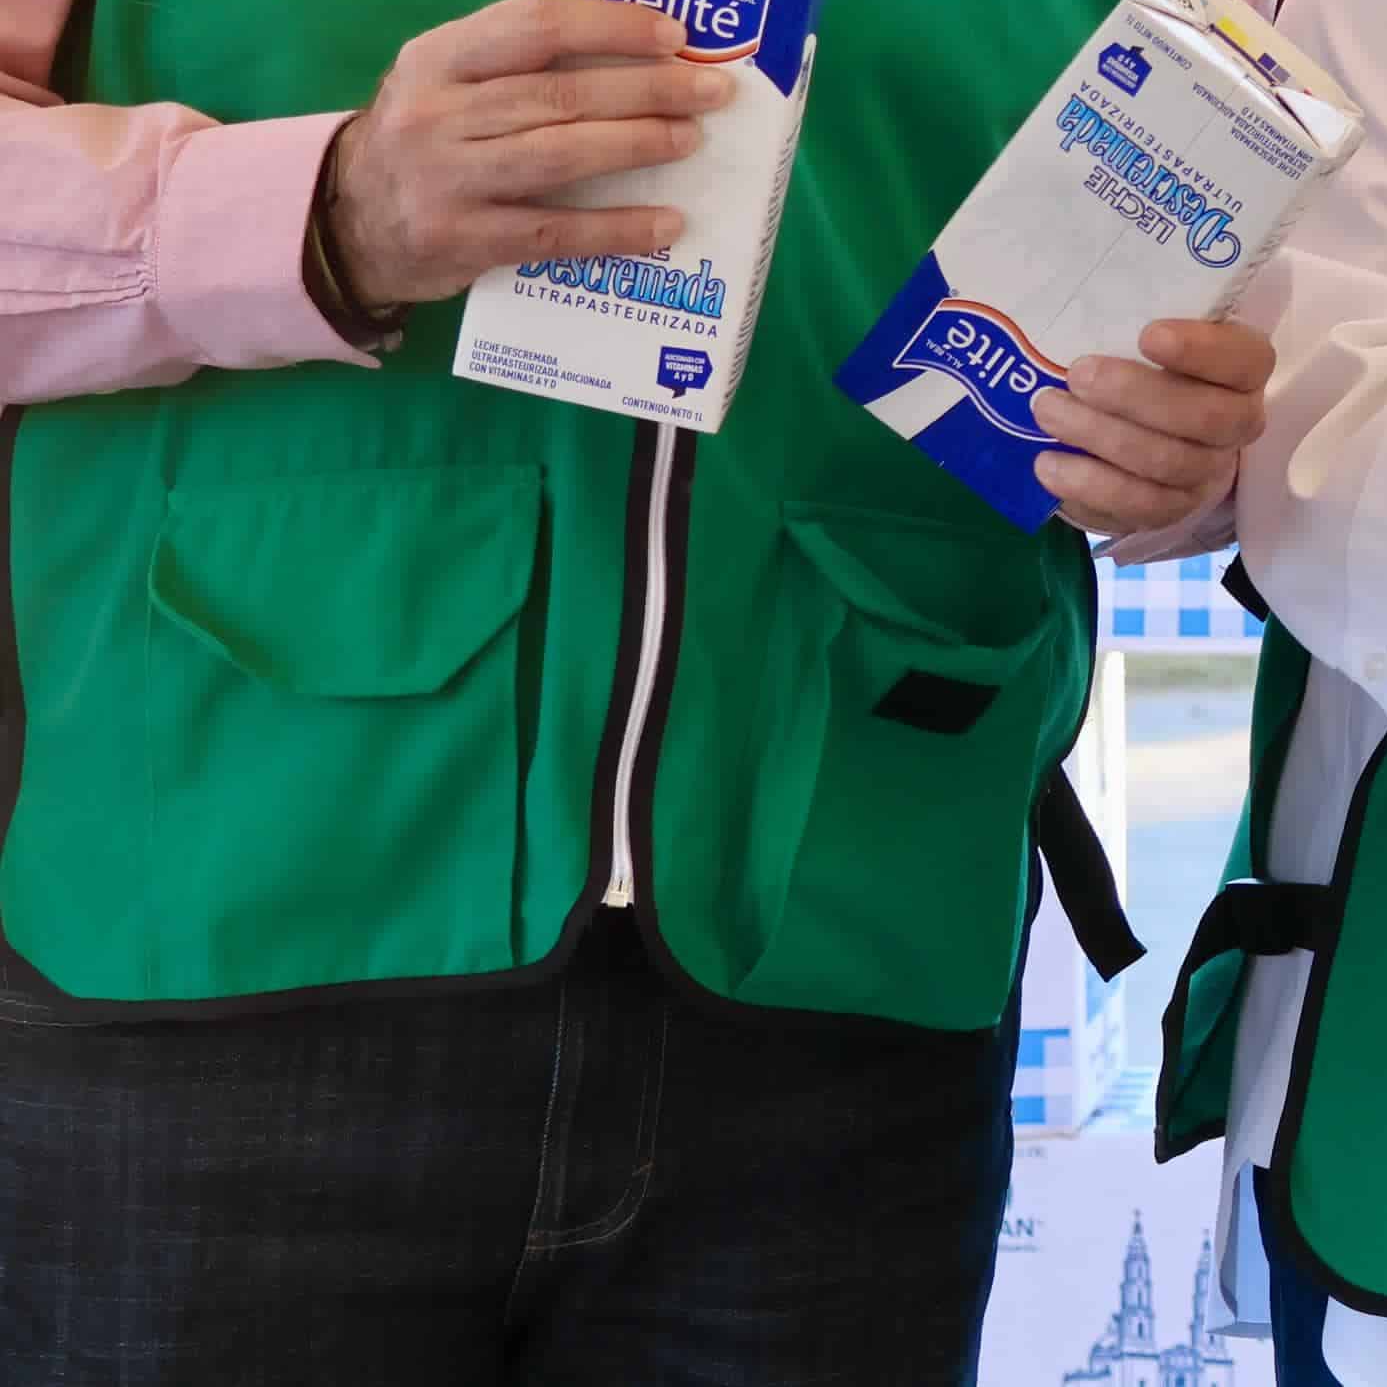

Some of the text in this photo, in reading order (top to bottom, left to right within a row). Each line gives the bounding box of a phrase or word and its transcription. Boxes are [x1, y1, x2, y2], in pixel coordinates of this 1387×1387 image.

[1079, 79, 1244, 214] ULTRAPASTEURIZADA
[1056, 93, 1241, 269] Descremada
[1084, 165, 1177, 245] LECHE
[513, 281, 719, 337] ULTRAPASTEURIZADA
[468, 361, 487, 373] CON
[488, 365, 534, 384] VITAMINAS
[471, 349, 612, 390] ULTRAPASTEURIZADA ADICIONADA
[473, 338, 558, 367] LECHE DESCREMADA
[947, 319, 1042, 397] elité
[622, 396, 669, 414] CONTENIDO
[670, 407, 692, 419] NETO
